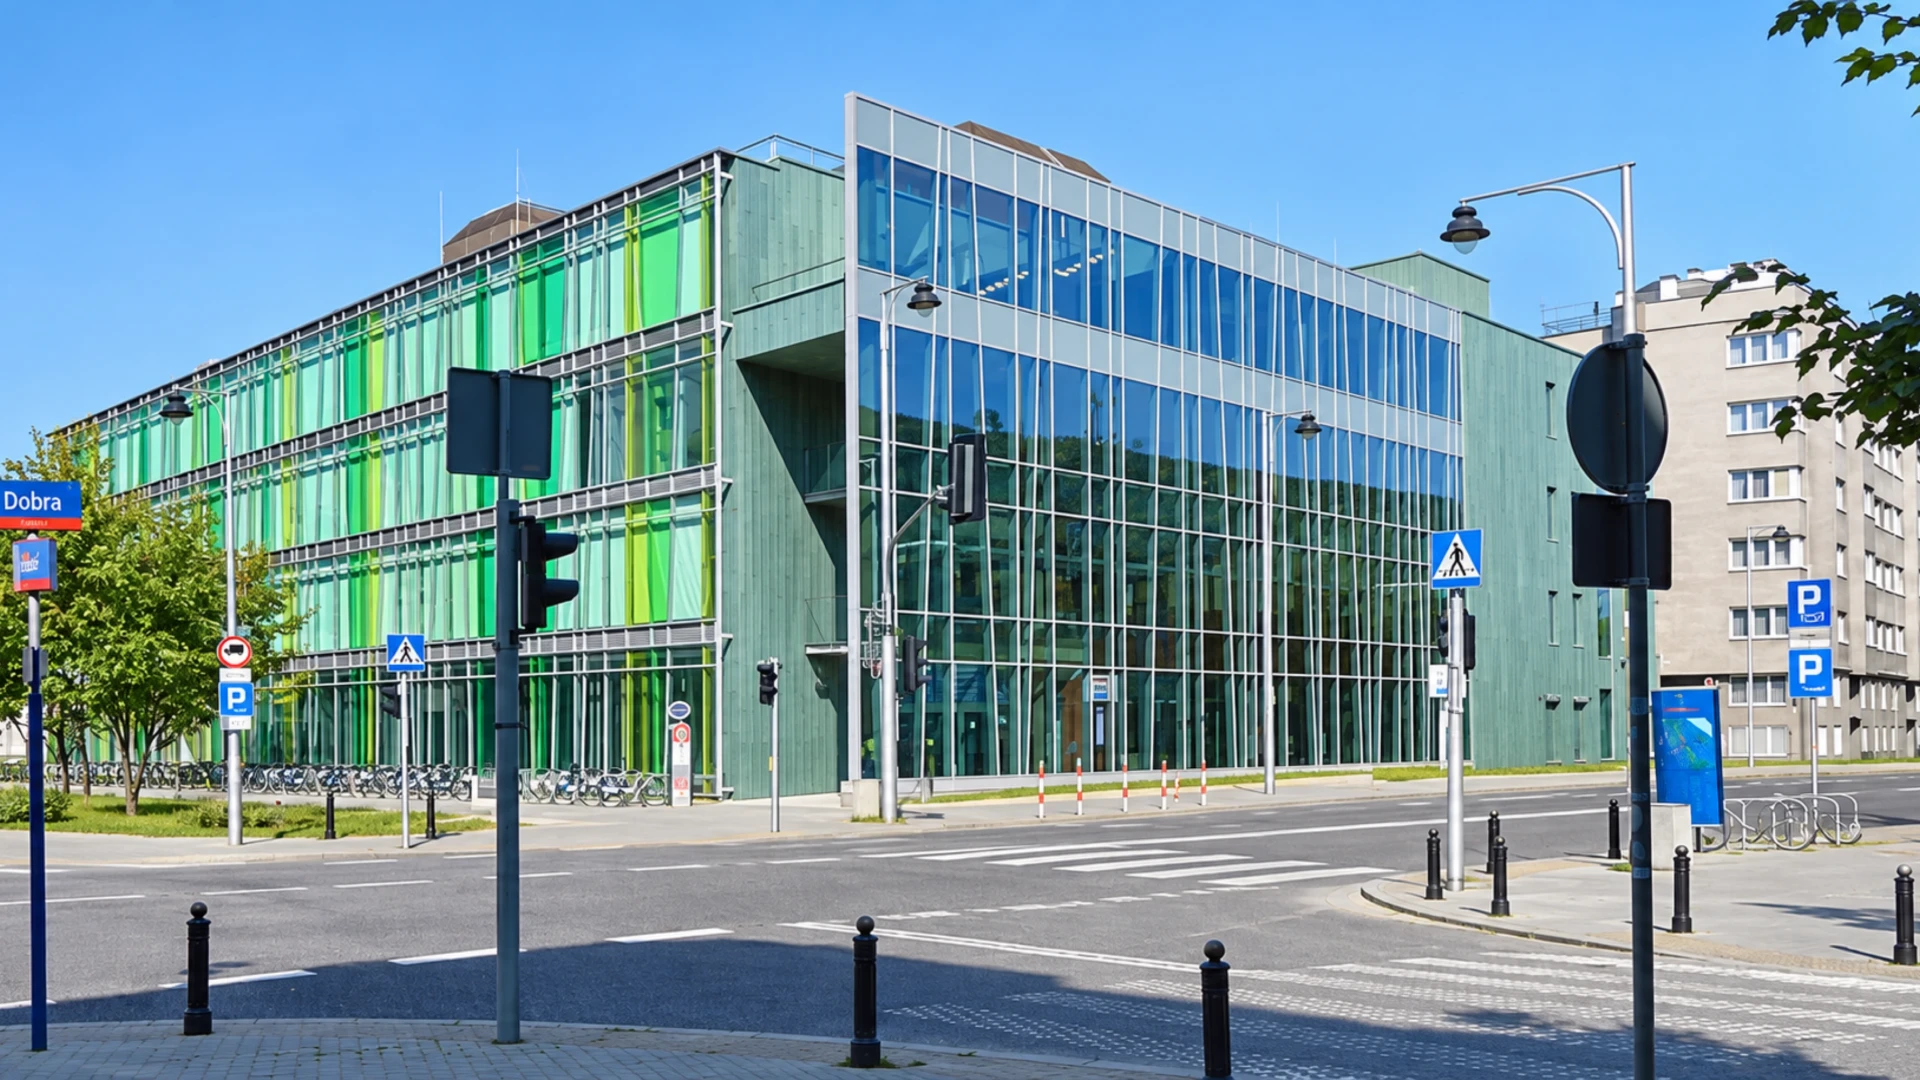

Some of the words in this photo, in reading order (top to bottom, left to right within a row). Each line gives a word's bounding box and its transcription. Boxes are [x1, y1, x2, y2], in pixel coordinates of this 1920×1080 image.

[4, 491, 62, 511] Dobra
[1797, 585, 1821, 614] P
[1798, 655, 1822, 684] P
[227, 687, 246, 710] P
